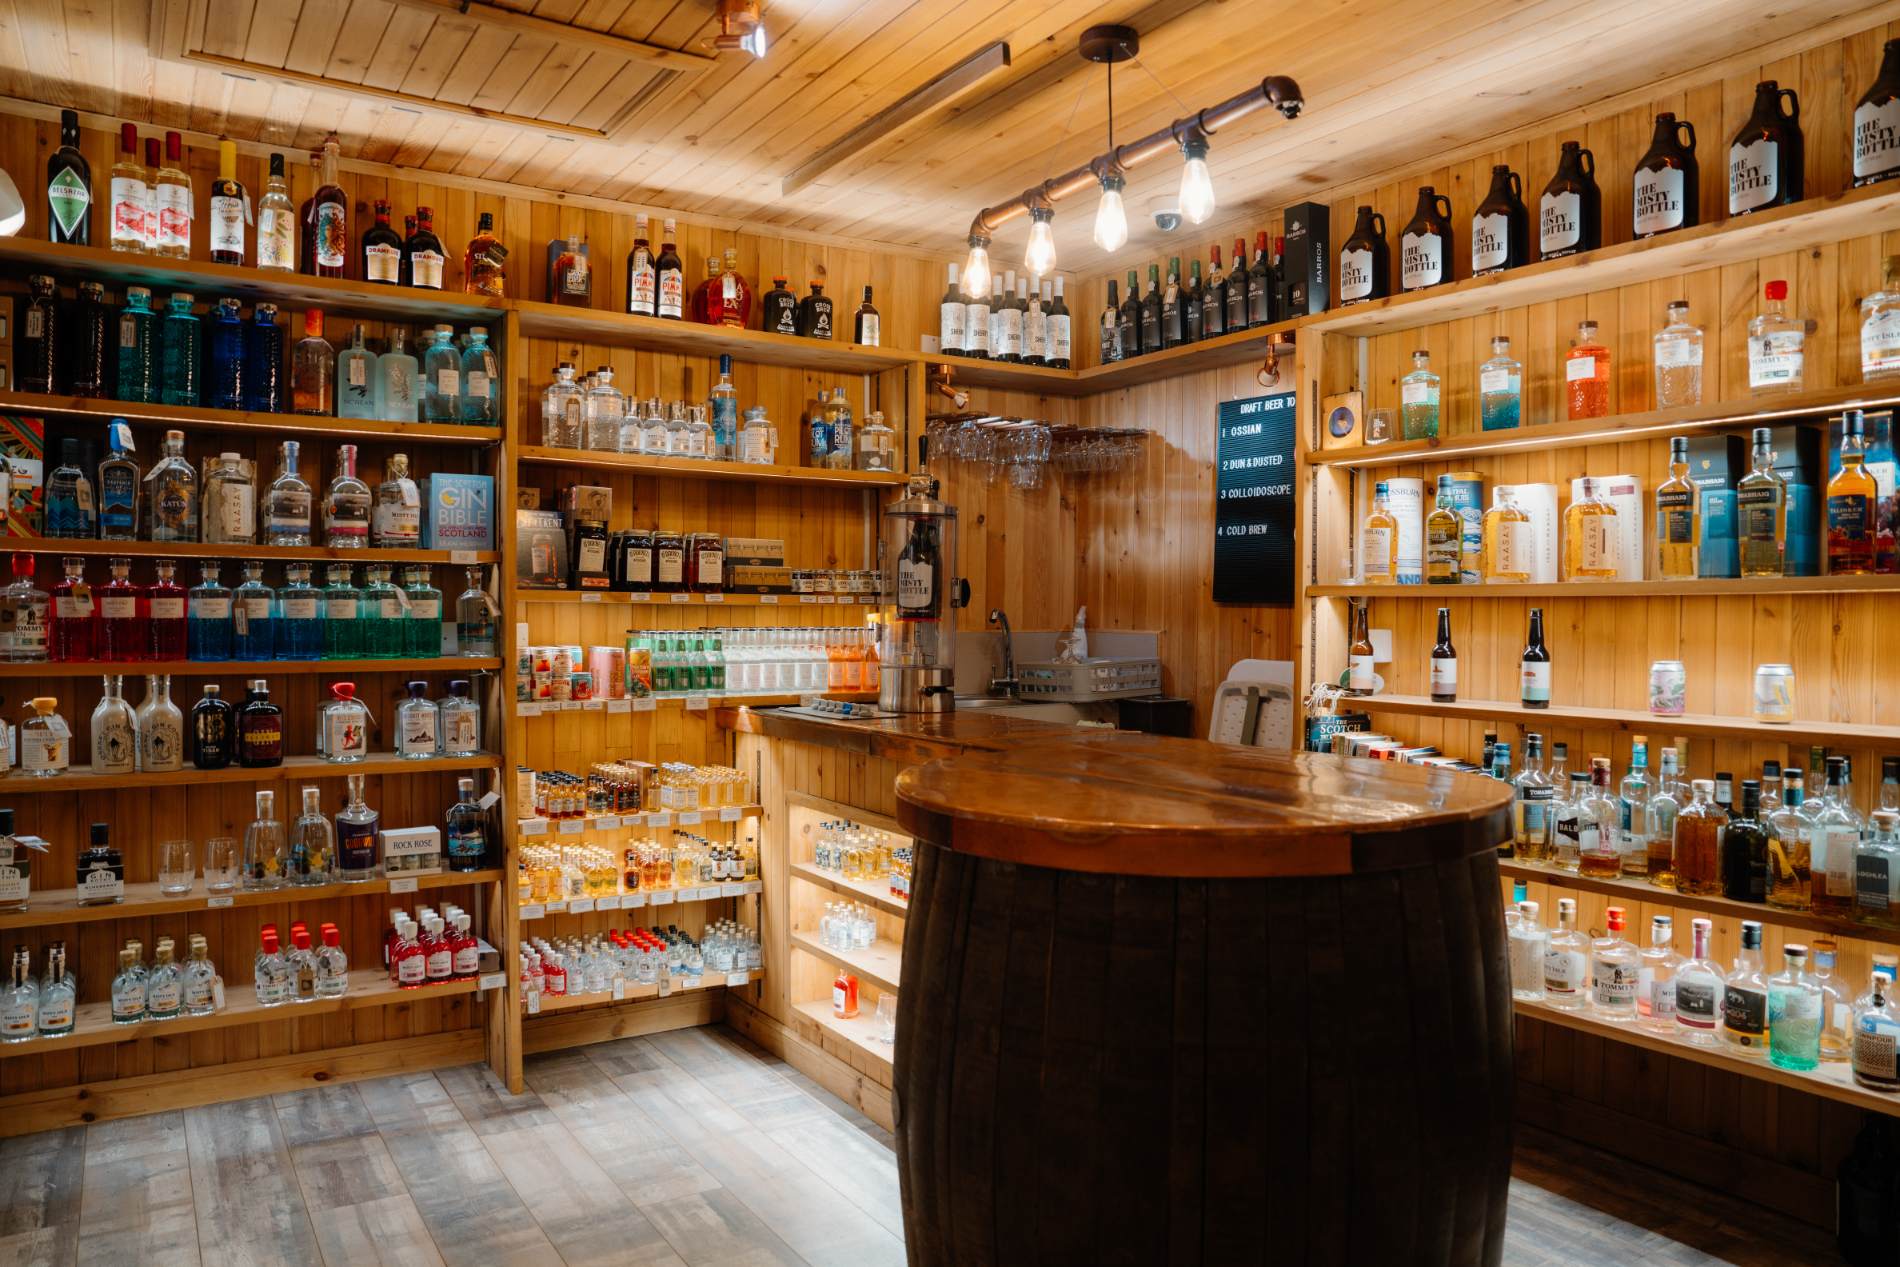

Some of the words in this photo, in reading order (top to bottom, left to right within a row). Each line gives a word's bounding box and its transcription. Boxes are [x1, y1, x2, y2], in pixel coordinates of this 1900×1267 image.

[1856, 118, 1881, 132] THE
[1856, 125, 1897, 144] MISTY
[1856, 137, 1900, 160] BOTTL
[1636, 182, 1657, 196] THE
[1636, 190, 1670, 206] MISTY
[1636, 201, 1680, 217] BOTTLE
[1240, 401, 1263, 414] DRAFT
[1264, 398, 1284, 411] BEER
[1222, 428, 1226, 438] 1
[1231, 424, 1262, 437] OSSIAN
[1222, 460, 1229, 471] 2
[1229, 458, 1246, 470] DUN
[1253, 454, 1283, 467] DUSTED
[438, 486, 488, 511] GIN
[1221, 489, 1226, 499] 3
[1228, 484, 1292, 499] COLLOIDOSCOPE
[233, 487, 241, 532] RAASAY
[438, 508, 488, 528] BIBLE
[438, 529, 488, 538] SCOTLAND
[1217, 526, 1223, 536] 4
[1226, 524, 1247, 536] COLD
[1248, 523, 1268, 535] BREW
[1502, 524, 1510, 570] RAASAY
[1588, 518, 1597, 567] RAASAY
[901, 571, 915, 579] THE
[1319, 724, 1361, 734] SCOTCH
[393, 841, 413, 849] ROCK
[414, 839, 433, 848] ROSE
[90, 872, 112, 880] GIN
